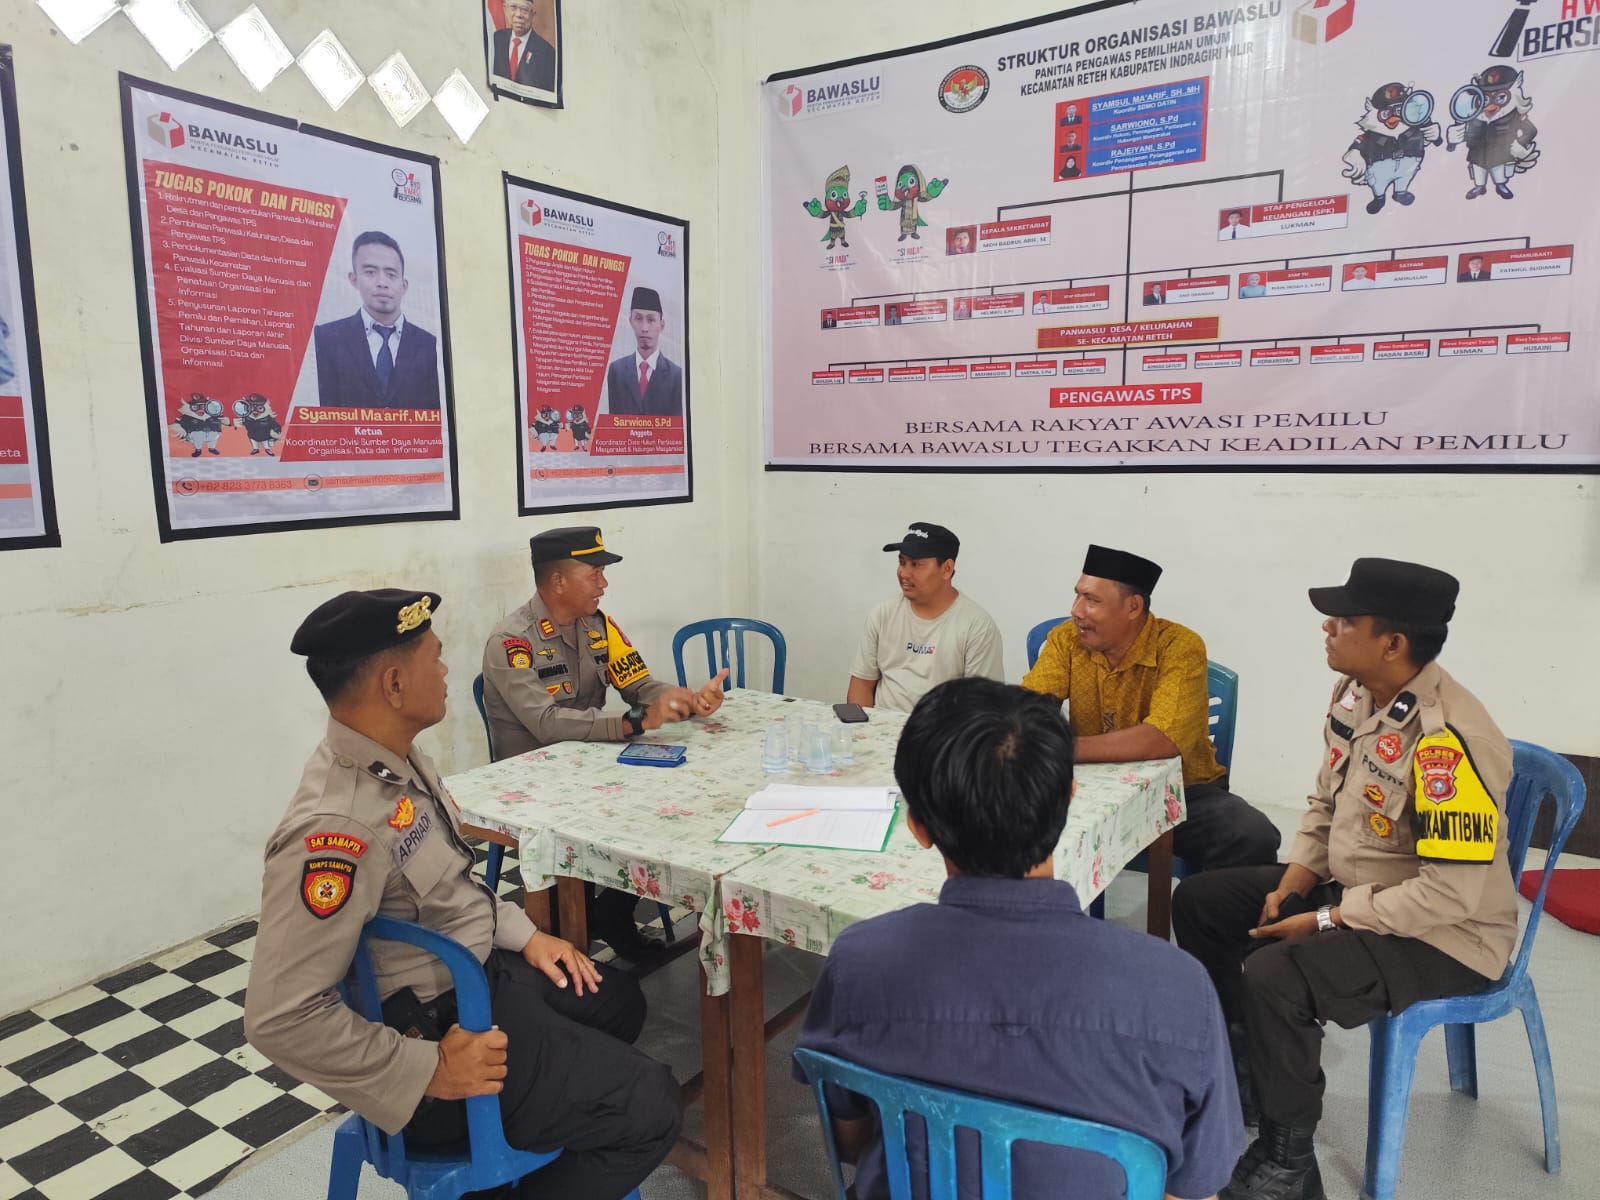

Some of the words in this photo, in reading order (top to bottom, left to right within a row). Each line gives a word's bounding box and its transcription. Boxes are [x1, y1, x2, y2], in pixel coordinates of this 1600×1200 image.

[997, 40, 1080, 72] STRUKTUR
[1085, 20, 1188, 54] ORGANISASI
[1193, 0, 1283, 30] BAWASLU
[1035, 61, 1073, 80] PANITIA
[1075, 50, 1132, 72] PENGAWAS
[1135, 40, 1193, 61] PEMILIHAN
[1196, 31, 1231, 49] UMUM
[1020, 76, 1075, 97] KECAMATAN
[1077, 69, 1108, 86] RETEH
[1110, 59, 1167, 81] KABUPATEN
[1170, 50, 1223, 69] INDRAGIRI
[1225, 41, 1254, 59] HILIR
[807, 76, 880, 103] BAWASLU
[1092, 99, 1130, 111] SYAMSUL
[1160, 115, 1179, 124] S.Pd
[188, 124, 278, 155] BAWASLU
[155, 170, 203, 194] TUGAS
[207, 180, 253, 204] POKOK
[260, 191, 287, 212] DAN
[290, 197, 335, 219] FUNGSI
[1263, 204, 1284, 213] STAF
[1285, 198, 1335, 211] PENGELOLA
[242, 217, 257, 227] TPS
[543, 207, 594, 228] BAWASLU
[1262, 210, 1311, 221] KEUANGAN
[1312, 207, 1335, 218] (SPK)
[1280, 220, 1316, 230] LUKMAN
[211, 235, 226, 245] TPS
[524, 242, 550, 259] TUGAS
[551, 247, 579, 264] POKOK
[582, 253, 599, 268] DAN
[599, 257, 625, 273] FUNGSI
[209, 268, 240, 279] Sumber
[1060, 327, 1106, 337] PANWASLU
[1110, 325, 1132, 334] DESA
[1133, 324, 1138, 333] /
[1139, 321, 1193, 331] KELURAHAN
[1091, 334, 1145, 345] KECAMATAN
[1145, 333, 1173, 342] RETEH
[1059, 389, 1155, 404] PENGAWAS
[1159, 387, 1192, 400] TPS
[299, 407, 358, 423] Syamsul
[414, 410, 440, 422] M.H
[655, 417, 672, 427] S.Pd
[905, 420, 1023, 434] BERSAMA
[1031, 417, 1139, 432] RAKYAT
[1145, 413, 1243, 431] AWASI
[1253, 411, 1389, 427] PEMILU
[354, 426, 383, 436] Ketua
[286, 438, 338, 447] Koordinator
[339, 437, 359, 446] Divisi
[360, 437, 390, 446] Sumber
[391, 437, 412, 448] Daya
[355, 446, 374, 454] Data
[375, 446, 390, 454] dan
[393, 446, 429, 454] Informasi
[809, 442, 914, 455] BERSAMA
[921, 440, 1040, 454] BAWASLU
[1047, 438, 1211, 454] TEGAKKAN
[1219, 435, 1402, 452] KEADILAN
[1413, 433, 1570, 450] PEMILU
[310, 837, 325, 848] SAT
[327, 836, 361, 853] SAMAPTA
[399, 811, 432, 862] APRIADI
[309, 861, 328, 870] KORPS
